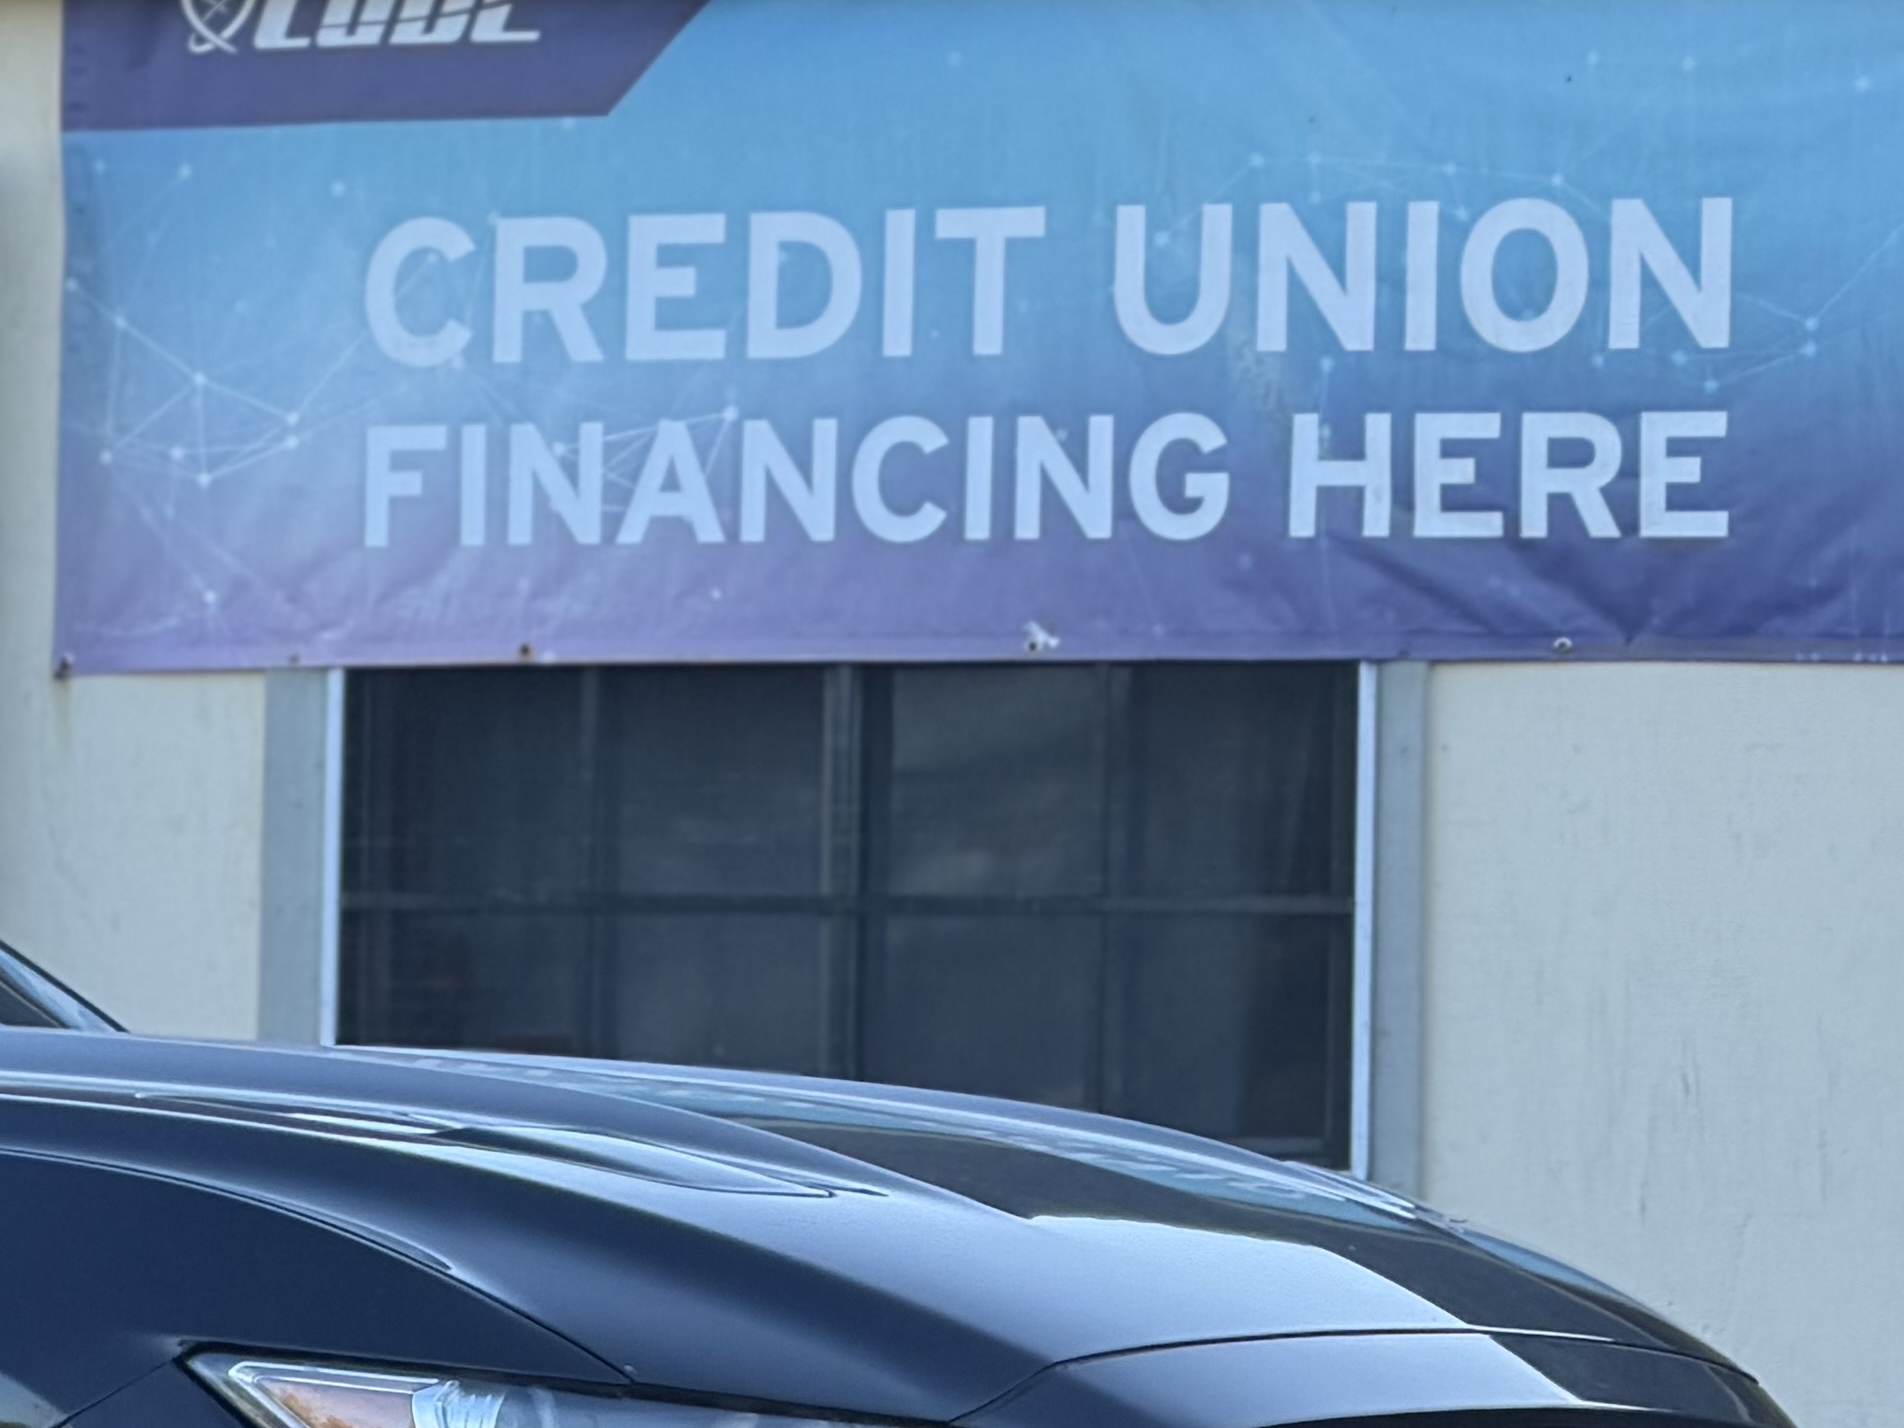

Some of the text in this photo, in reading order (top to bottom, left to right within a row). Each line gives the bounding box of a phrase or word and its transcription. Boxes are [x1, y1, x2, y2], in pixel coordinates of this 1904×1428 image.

[363, 195, 1734, 369] CREDIT UNION
[363, 410, 1732, 549] FINANCING HERE
